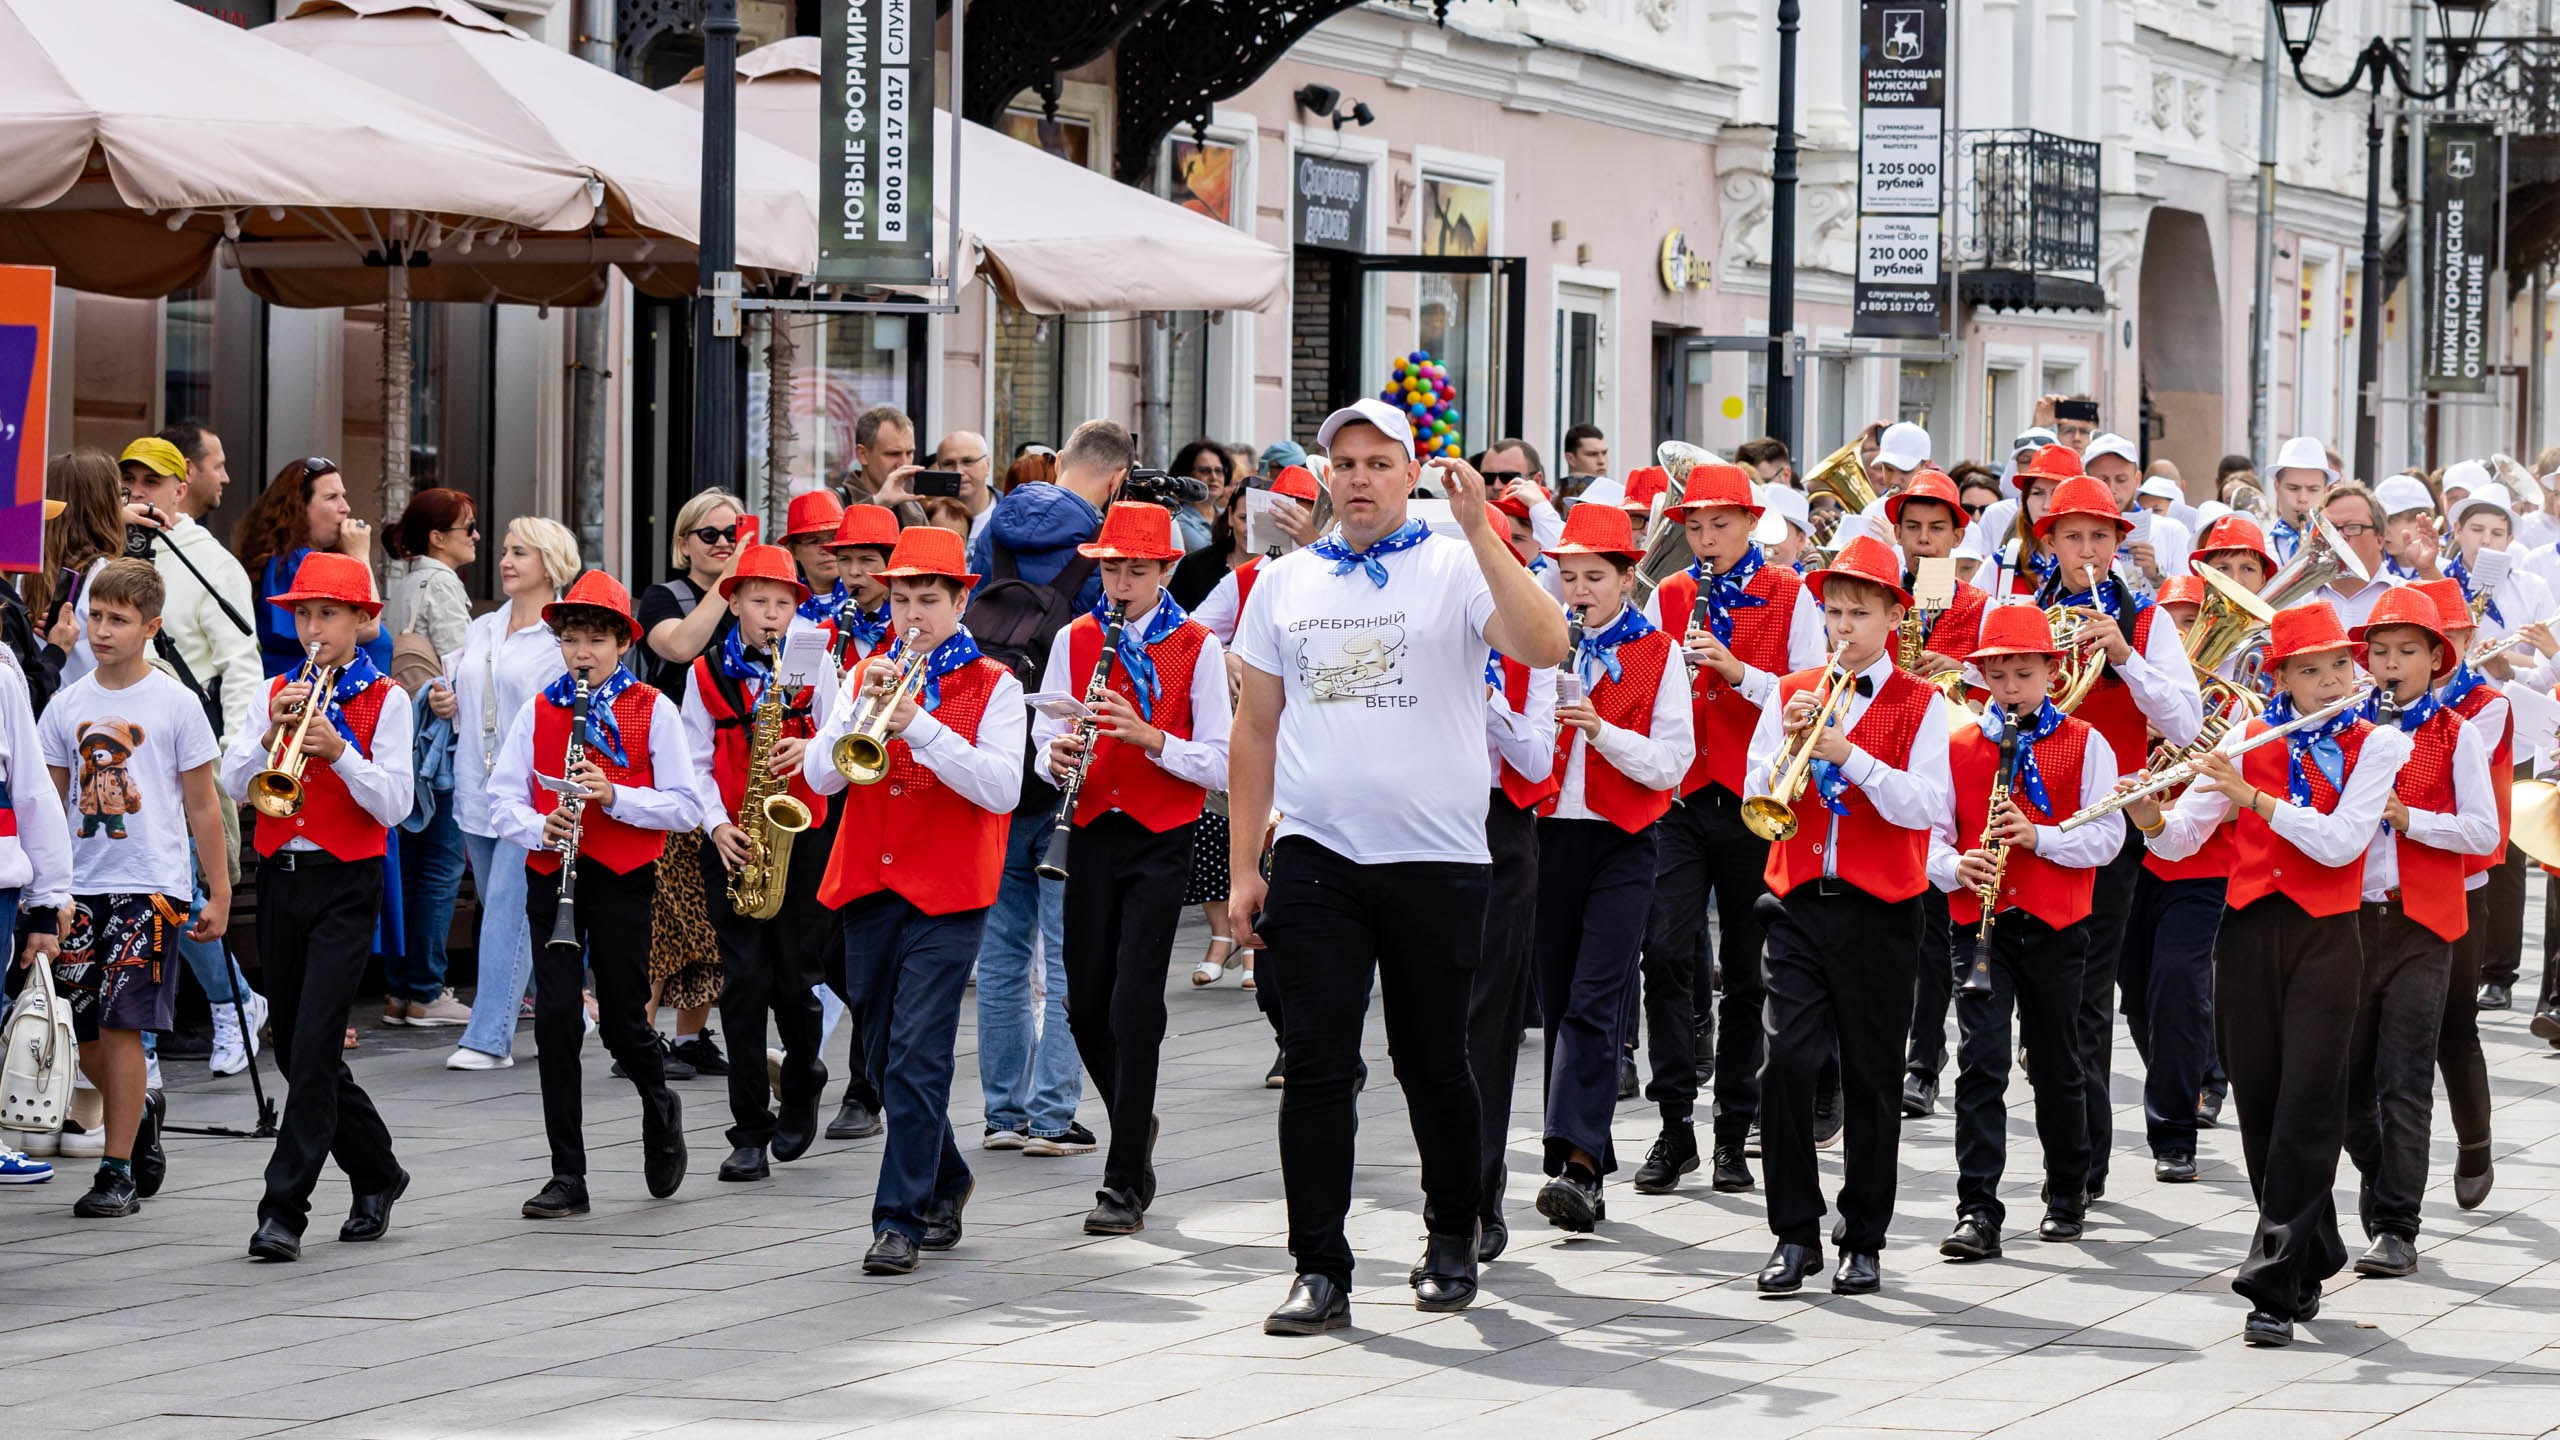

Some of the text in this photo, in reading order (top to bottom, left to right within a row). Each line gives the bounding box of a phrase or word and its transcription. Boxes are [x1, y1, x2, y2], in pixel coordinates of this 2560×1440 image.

[1868, 69, 1942, 79] НАСТОЯЩАЯ
[1868, 81, 1927, 90] МУЖСКАЯ
[1868, 93, 1914, 101] РАБОТА
[843, 0, 868, 240] НОВЫЕ ФОРМИР
[886, 75, 903, 232] 8 800 10 17 017
[1866, 162, 1936, 175] 1 205 000
[1877, 177, 1924, 192] рублей
[1884, 224, 1911, 232] оклад
[1897, 232, 1917, 240] СВО
[1869, 247, 1928, 260] 210 000
[1873, 262, 1923, 277] рублей
[2442, 199, 2464, 377] НИЖЕГОРОДСКОЕ
[1860, 302, 1935, 312] 8 800 10 17 017
[2464, 255, 2484, 378] ОПОЛЧЕНИЕ
[1288, 610, 1406, 633] СЕРЕБРЯНЫЙ
[1366, 695, 1418, 708] ВЕТЕР
[131, 932, 148, 957] day
